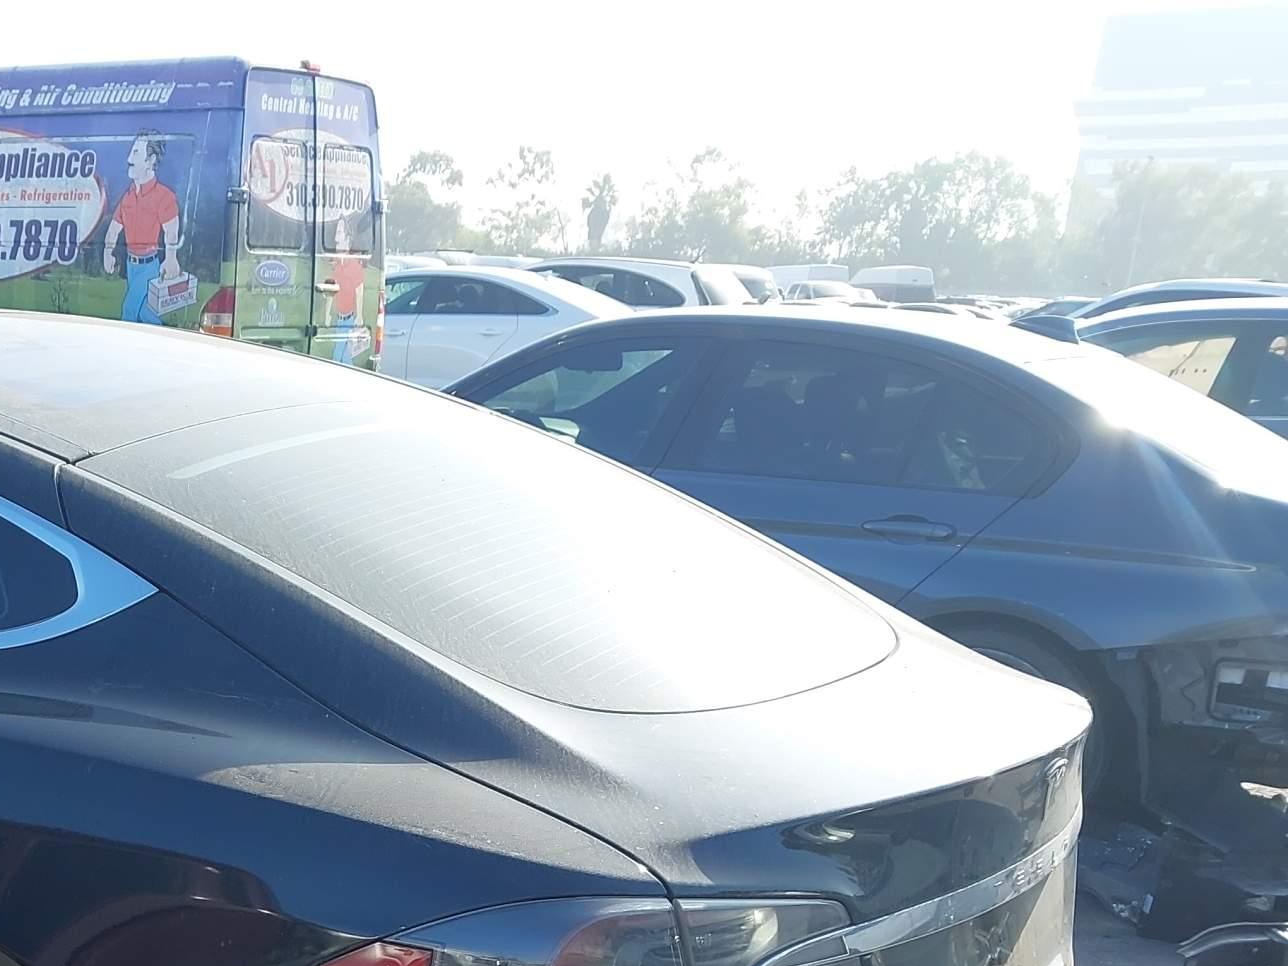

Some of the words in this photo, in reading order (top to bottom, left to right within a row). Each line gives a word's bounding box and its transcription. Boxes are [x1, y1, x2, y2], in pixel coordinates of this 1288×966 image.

[19, 88, 33, 107] &
[33, 85, 62, 107] Air
[60, 80, 175, 106] Conditioning
[261, 92, 297, 114] Central
[19, 187, 91, 204] Refrigeration
